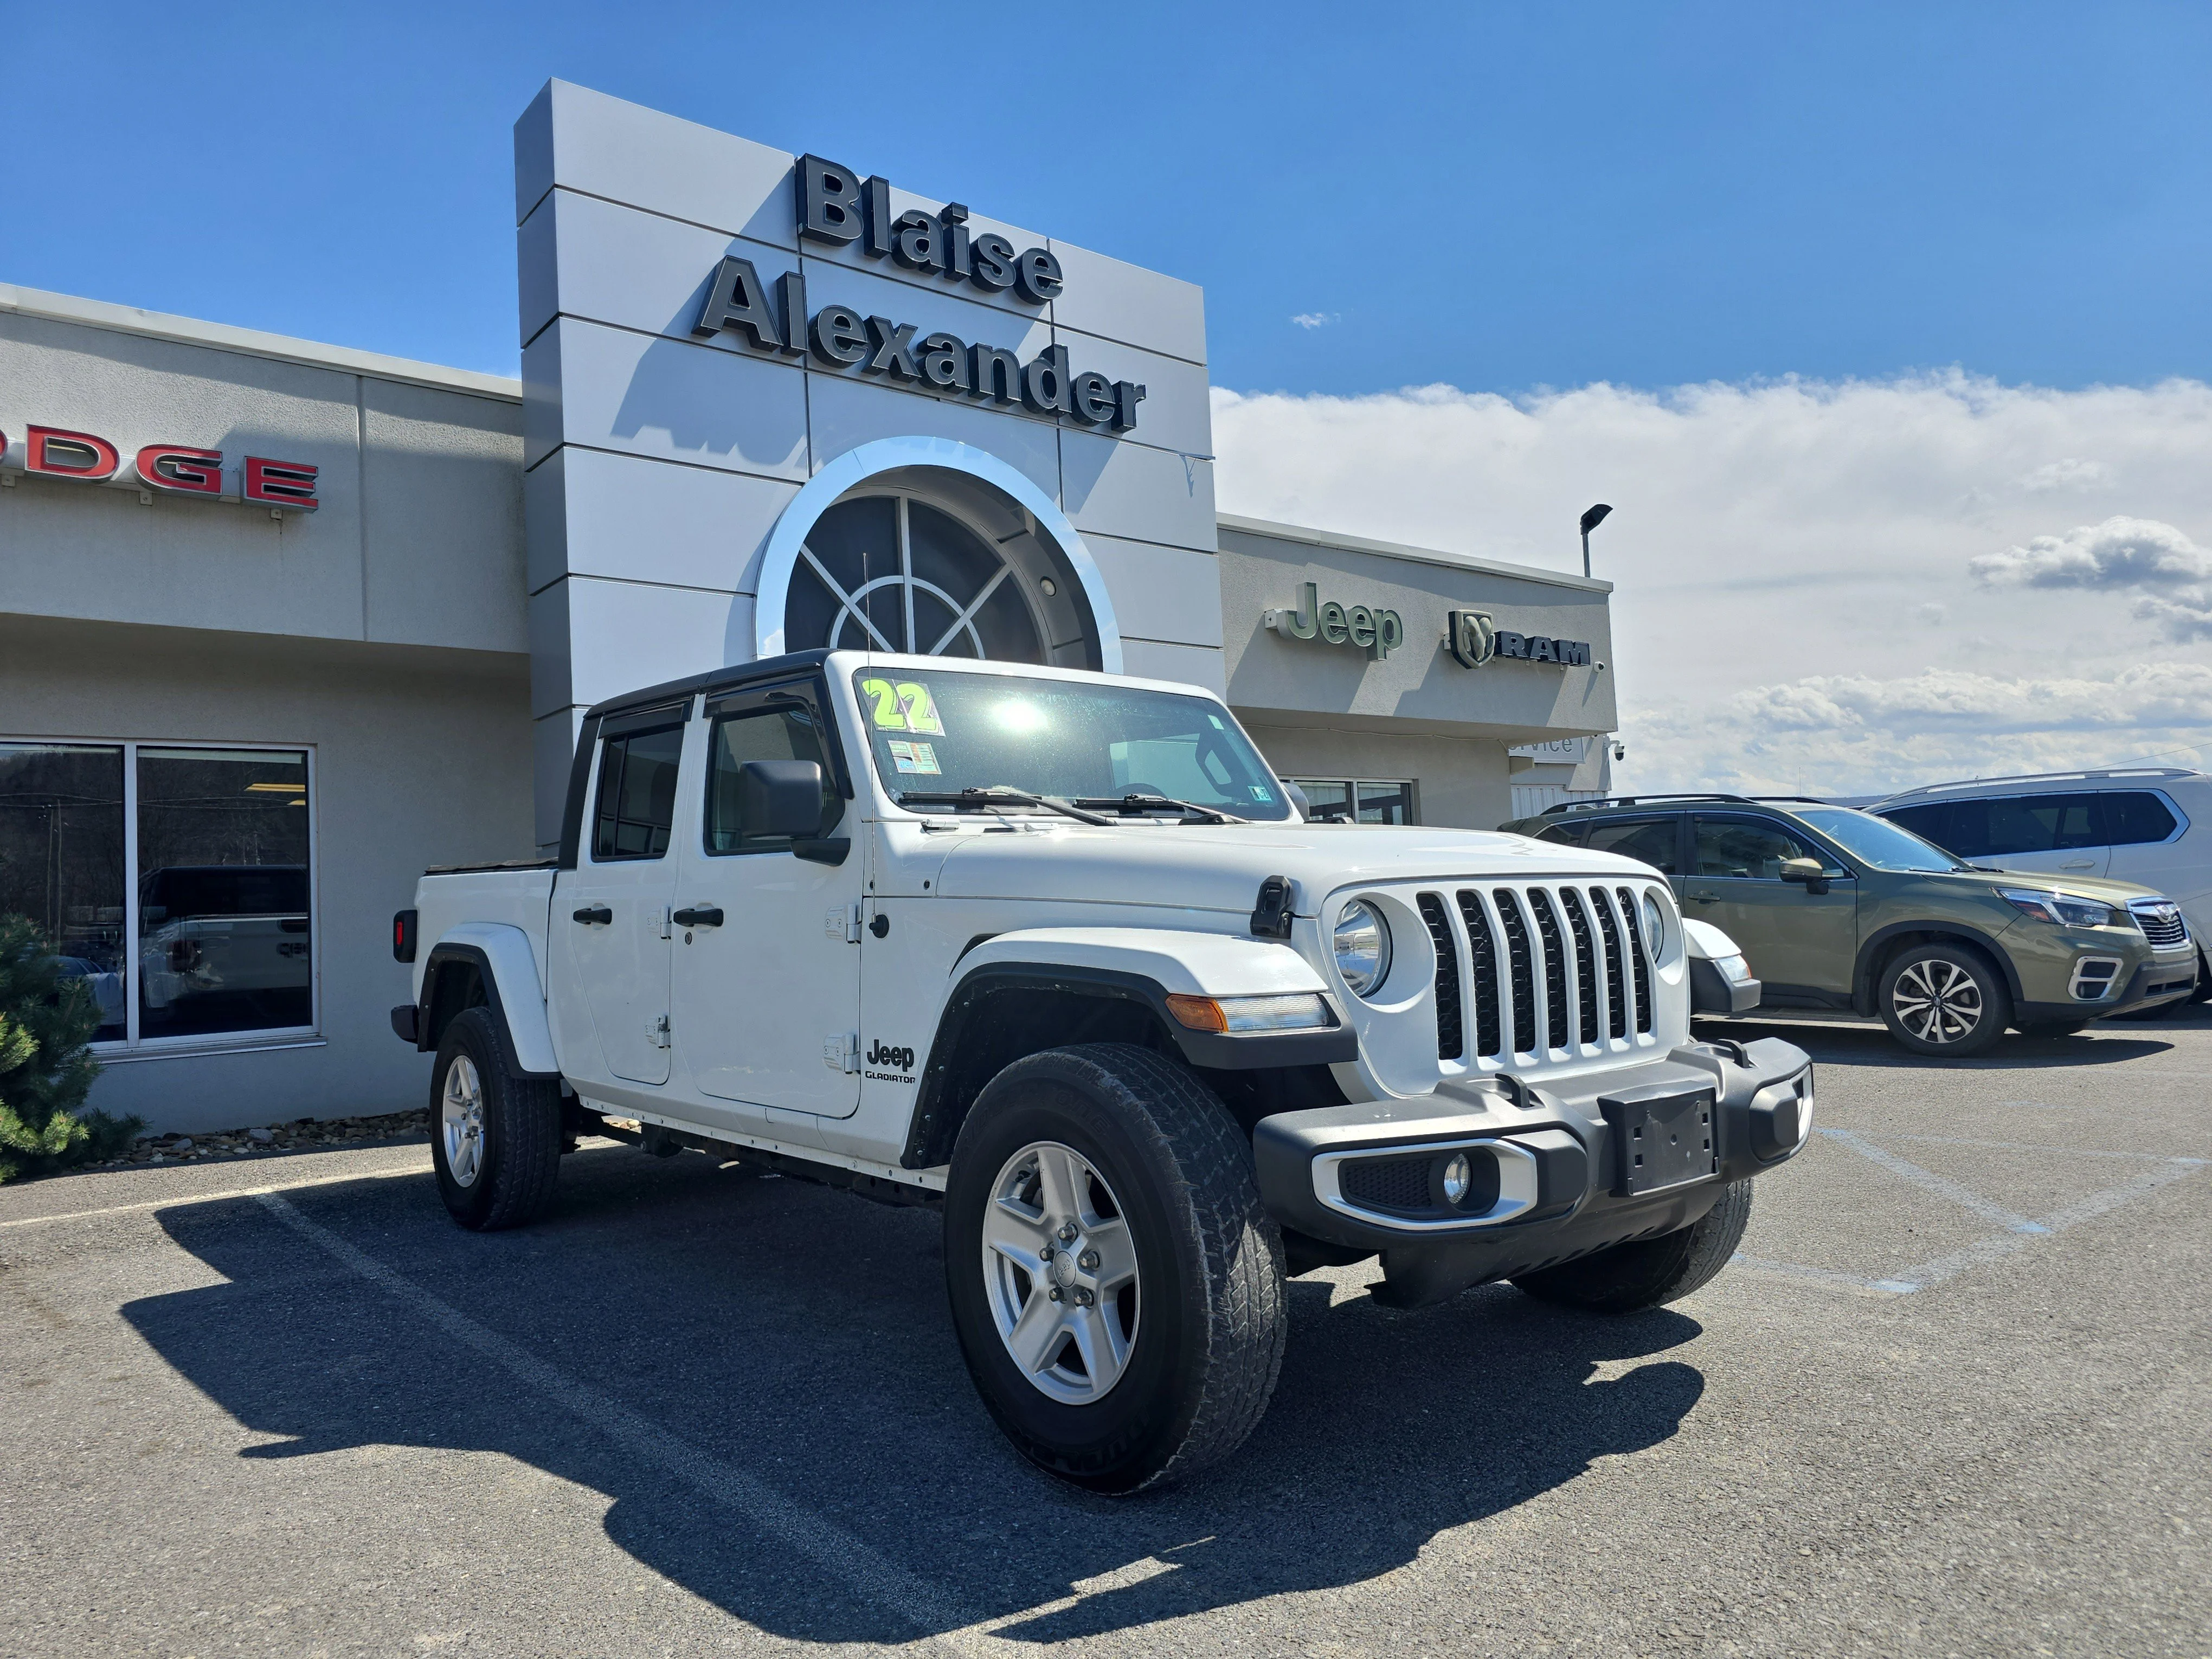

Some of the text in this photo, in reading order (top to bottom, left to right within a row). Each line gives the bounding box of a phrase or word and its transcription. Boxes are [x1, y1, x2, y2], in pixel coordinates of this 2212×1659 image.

[795, 153, 1063, 306] Blaise
[691, 255, 1146, 433] Alexander
[0, 424, 318, 513] DGE
[1277, 582, 1403, 662] Jeep
[1494, 631, 1590, 666] RAM
[862, 679, 939, 733] 22
[865, 1071, 915, 1083] GLADIATOR
[867, 1039, 914, 1072] Jeep
